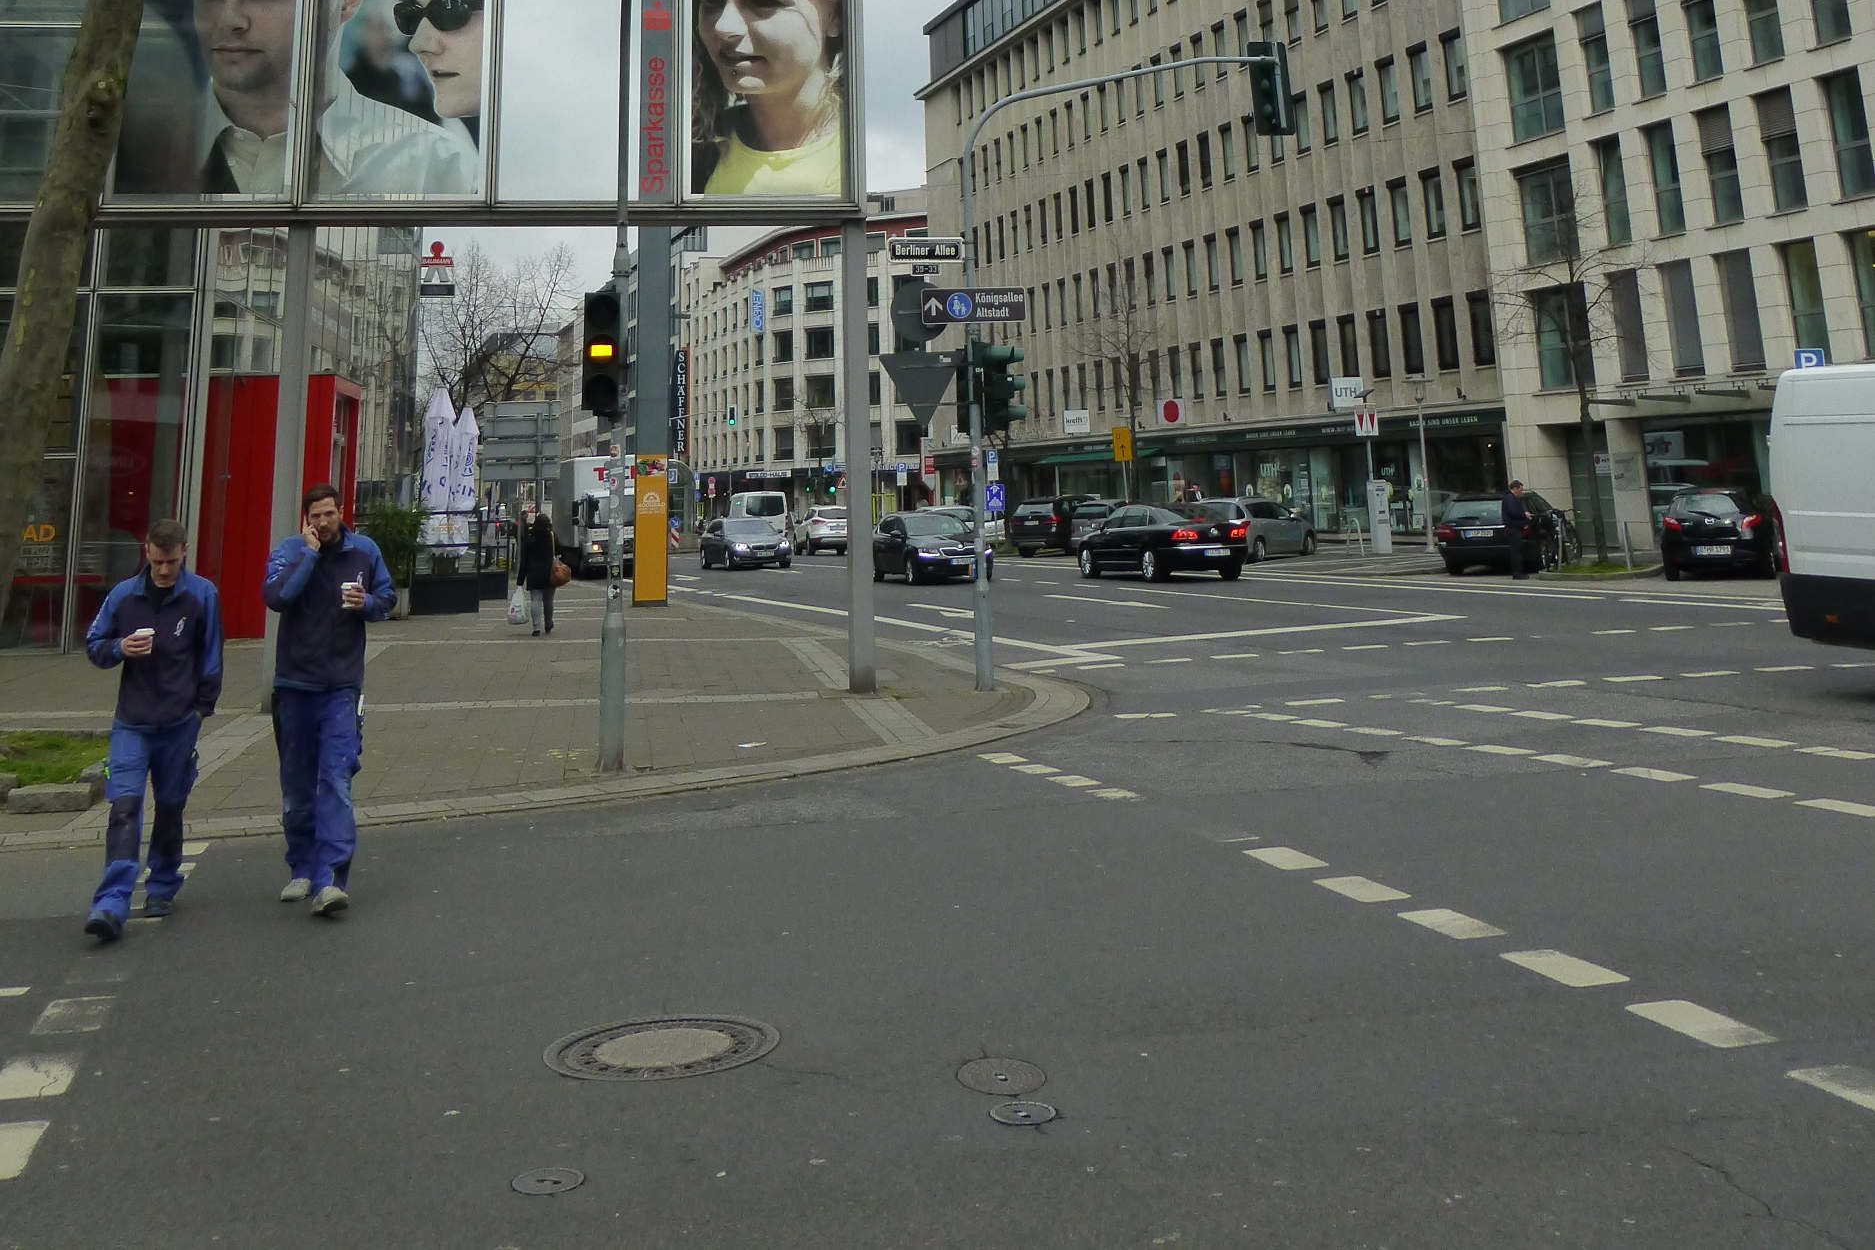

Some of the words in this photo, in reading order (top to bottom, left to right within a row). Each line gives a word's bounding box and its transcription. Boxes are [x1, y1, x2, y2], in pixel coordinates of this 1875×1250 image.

[640, 56, 669, 193] Sparkasse
[895, 244, 930, 256] Berliner
[934, 244, 956, 256] Allee
[975, 292, 1024, 305] Königsallee
[976, 307, 1009, 318] Altstadt
